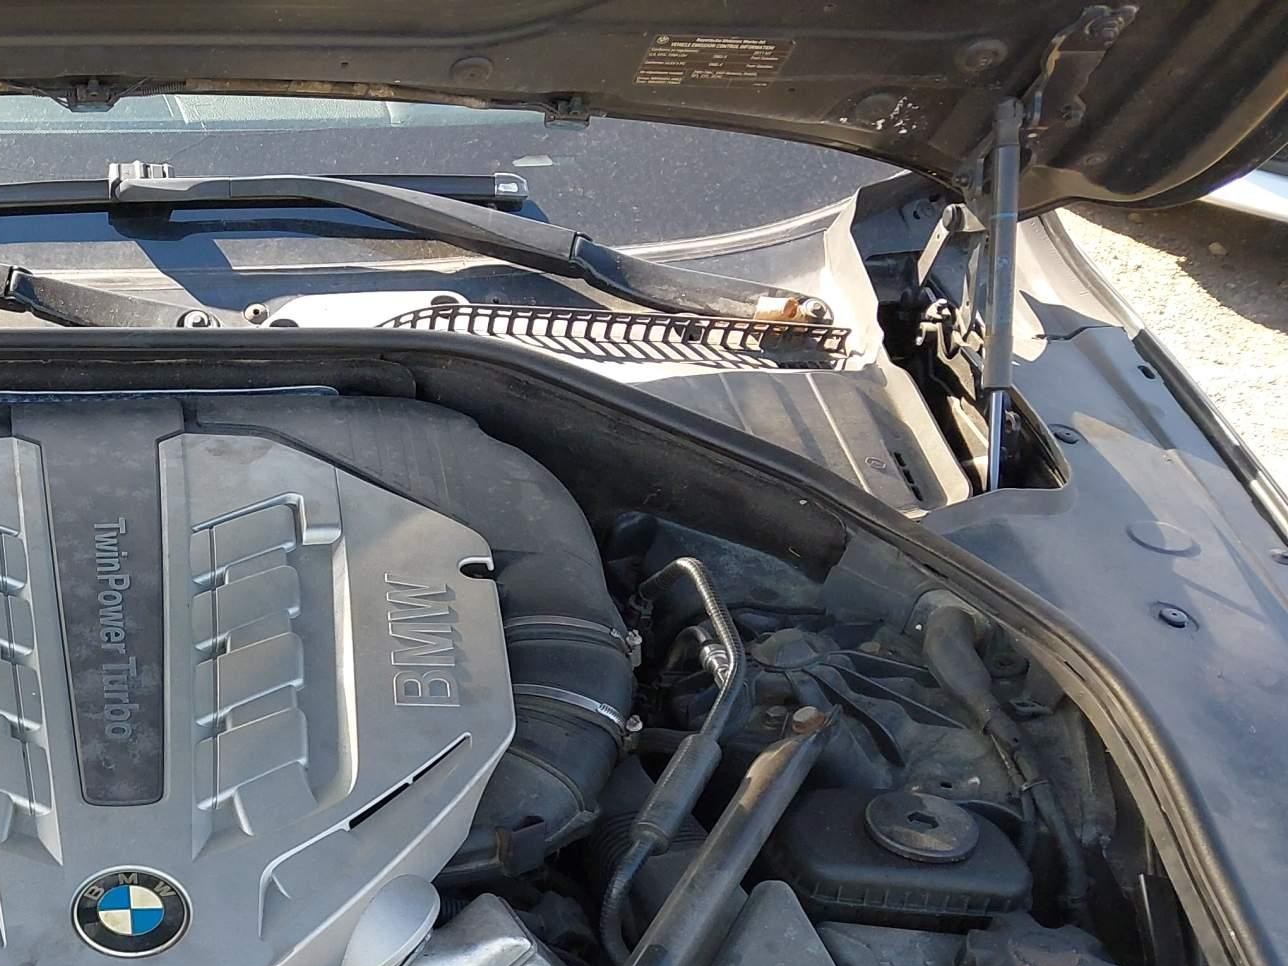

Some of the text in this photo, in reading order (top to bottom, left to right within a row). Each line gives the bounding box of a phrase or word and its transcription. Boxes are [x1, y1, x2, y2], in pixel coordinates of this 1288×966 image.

[94, 517, 139, 740] TwinPower Turbo
[385, 572, 460, 707] BMW
[84, 872, 176, 901] BMW
